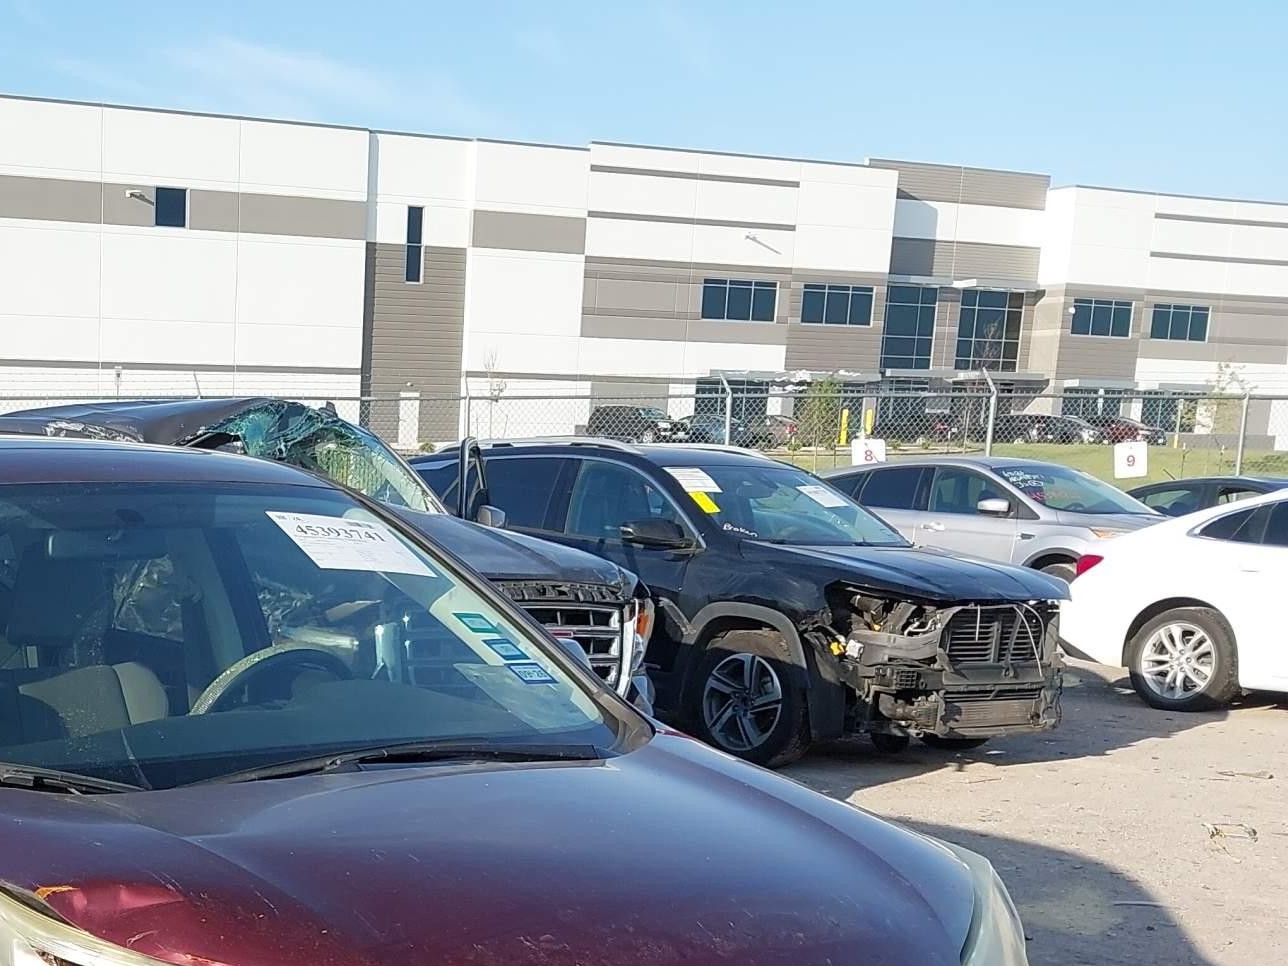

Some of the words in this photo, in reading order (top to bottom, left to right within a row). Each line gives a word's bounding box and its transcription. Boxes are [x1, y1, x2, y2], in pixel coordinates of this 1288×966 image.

[864, 449, 874, 462] 8
[1126, 454, 1136, 467] 9
[295, 524, 386, 543] 45393741
